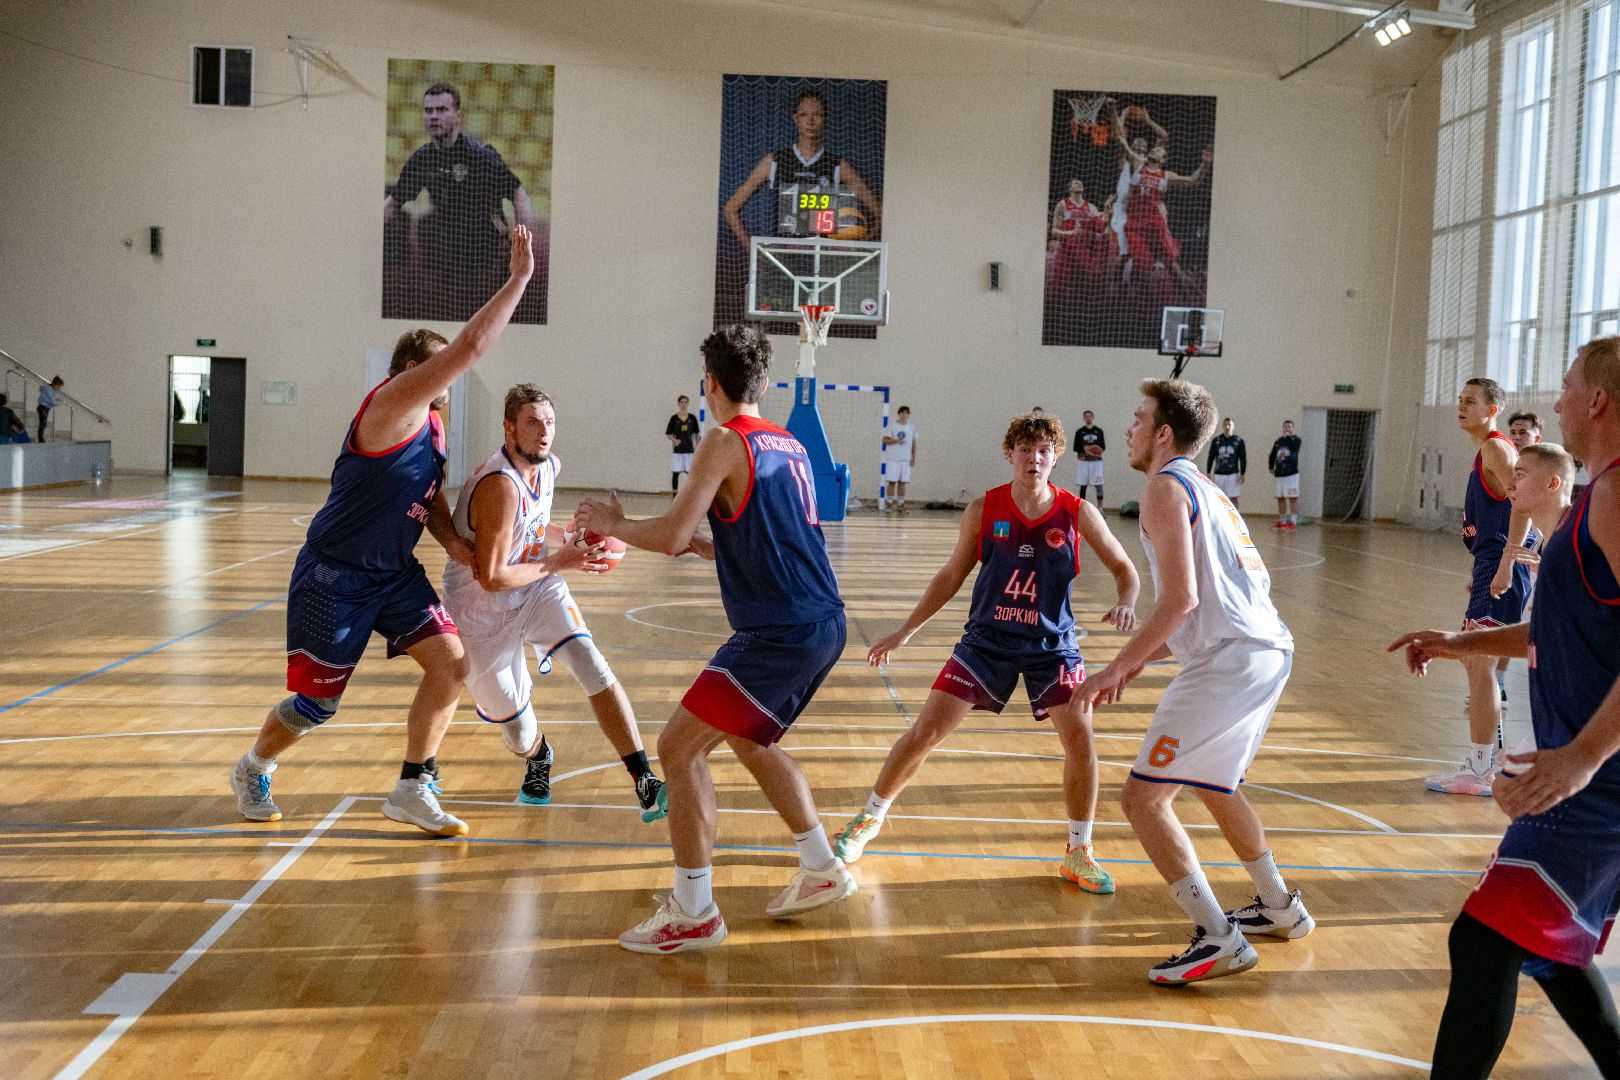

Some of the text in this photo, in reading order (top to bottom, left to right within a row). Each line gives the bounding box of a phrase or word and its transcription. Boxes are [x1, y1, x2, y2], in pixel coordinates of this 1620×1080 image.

[800, 194, 830, 209] 33.9
[816, 210, 834, 232] 15
[788, 459, 819, 525] 11
[1004, 569, 1037, 603] 44
[994, 605, 1039, 626] ЗОРКИЙ
[1148, 734, 1180, 768] 6
